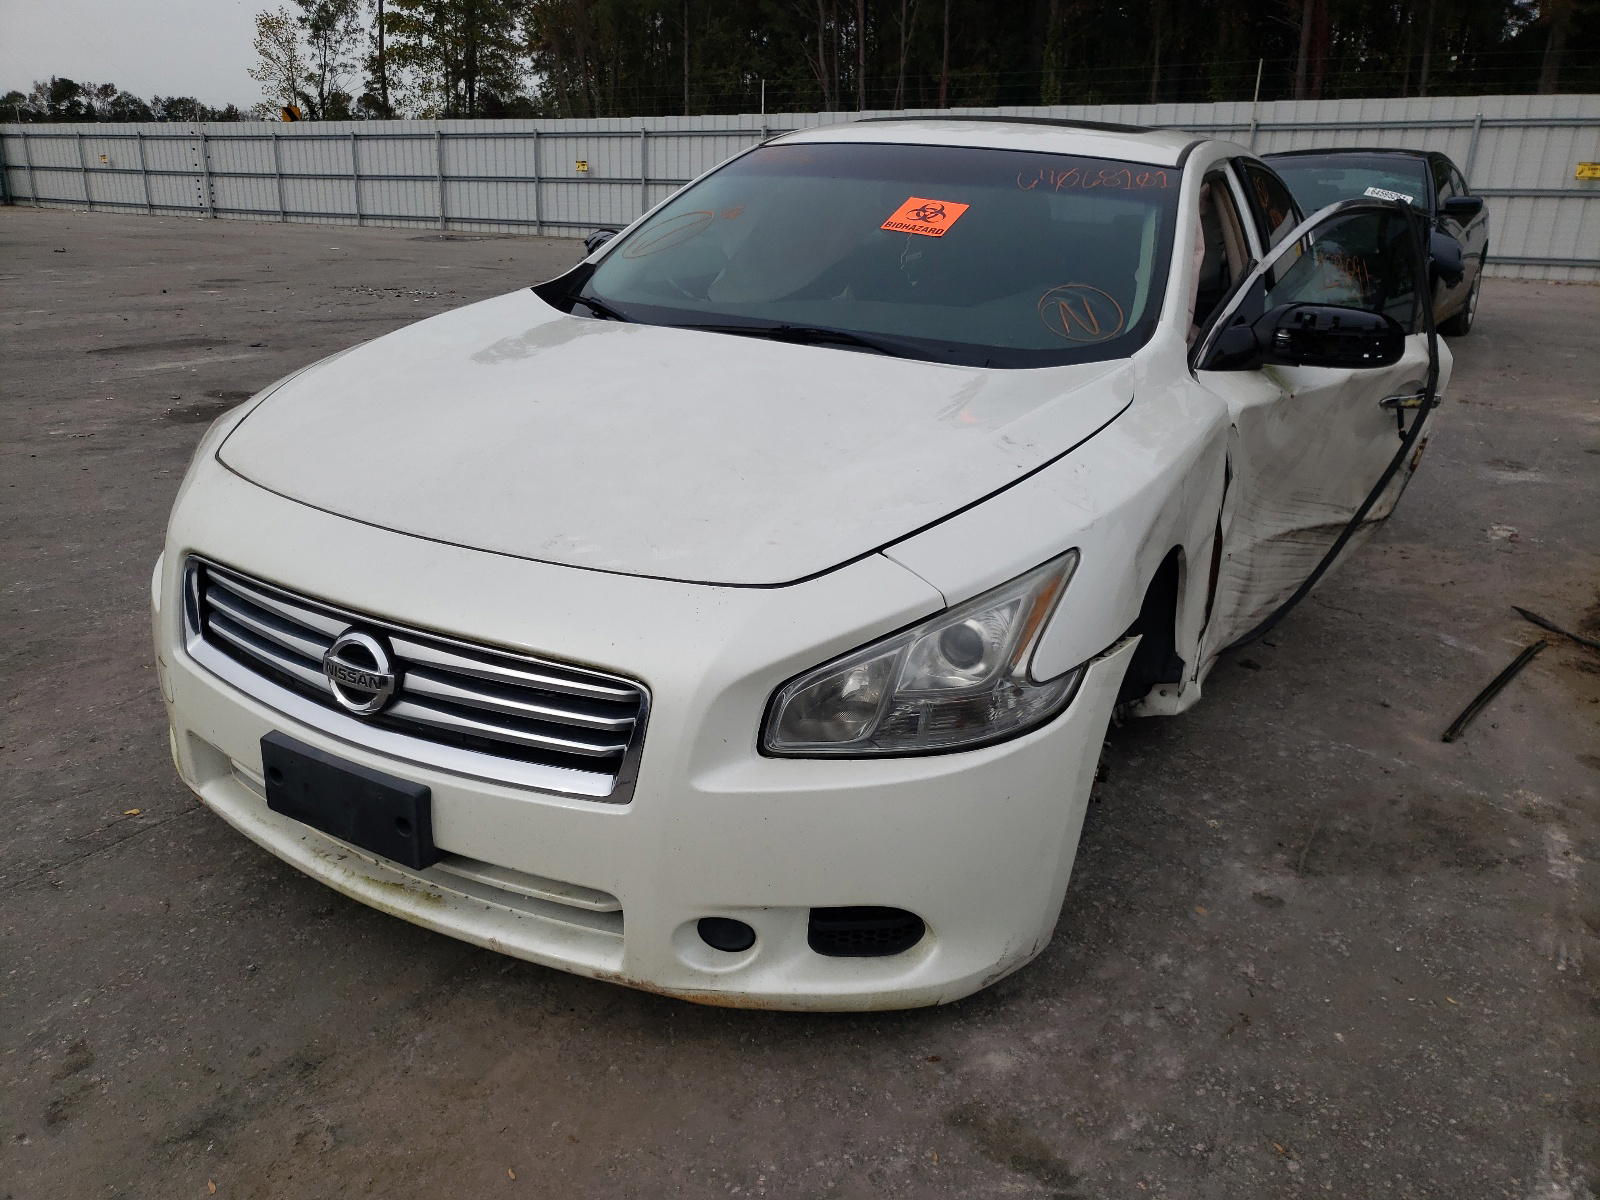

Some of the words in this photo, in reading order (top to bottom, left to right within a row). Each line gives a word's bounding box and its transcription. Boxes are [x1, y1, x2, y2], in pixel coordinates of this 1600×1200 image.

[884, 221, 945, 235] BIOHAZARD
[1059, 297, 1100, 335] N
[326, 661, 382, 690] NISSAN
